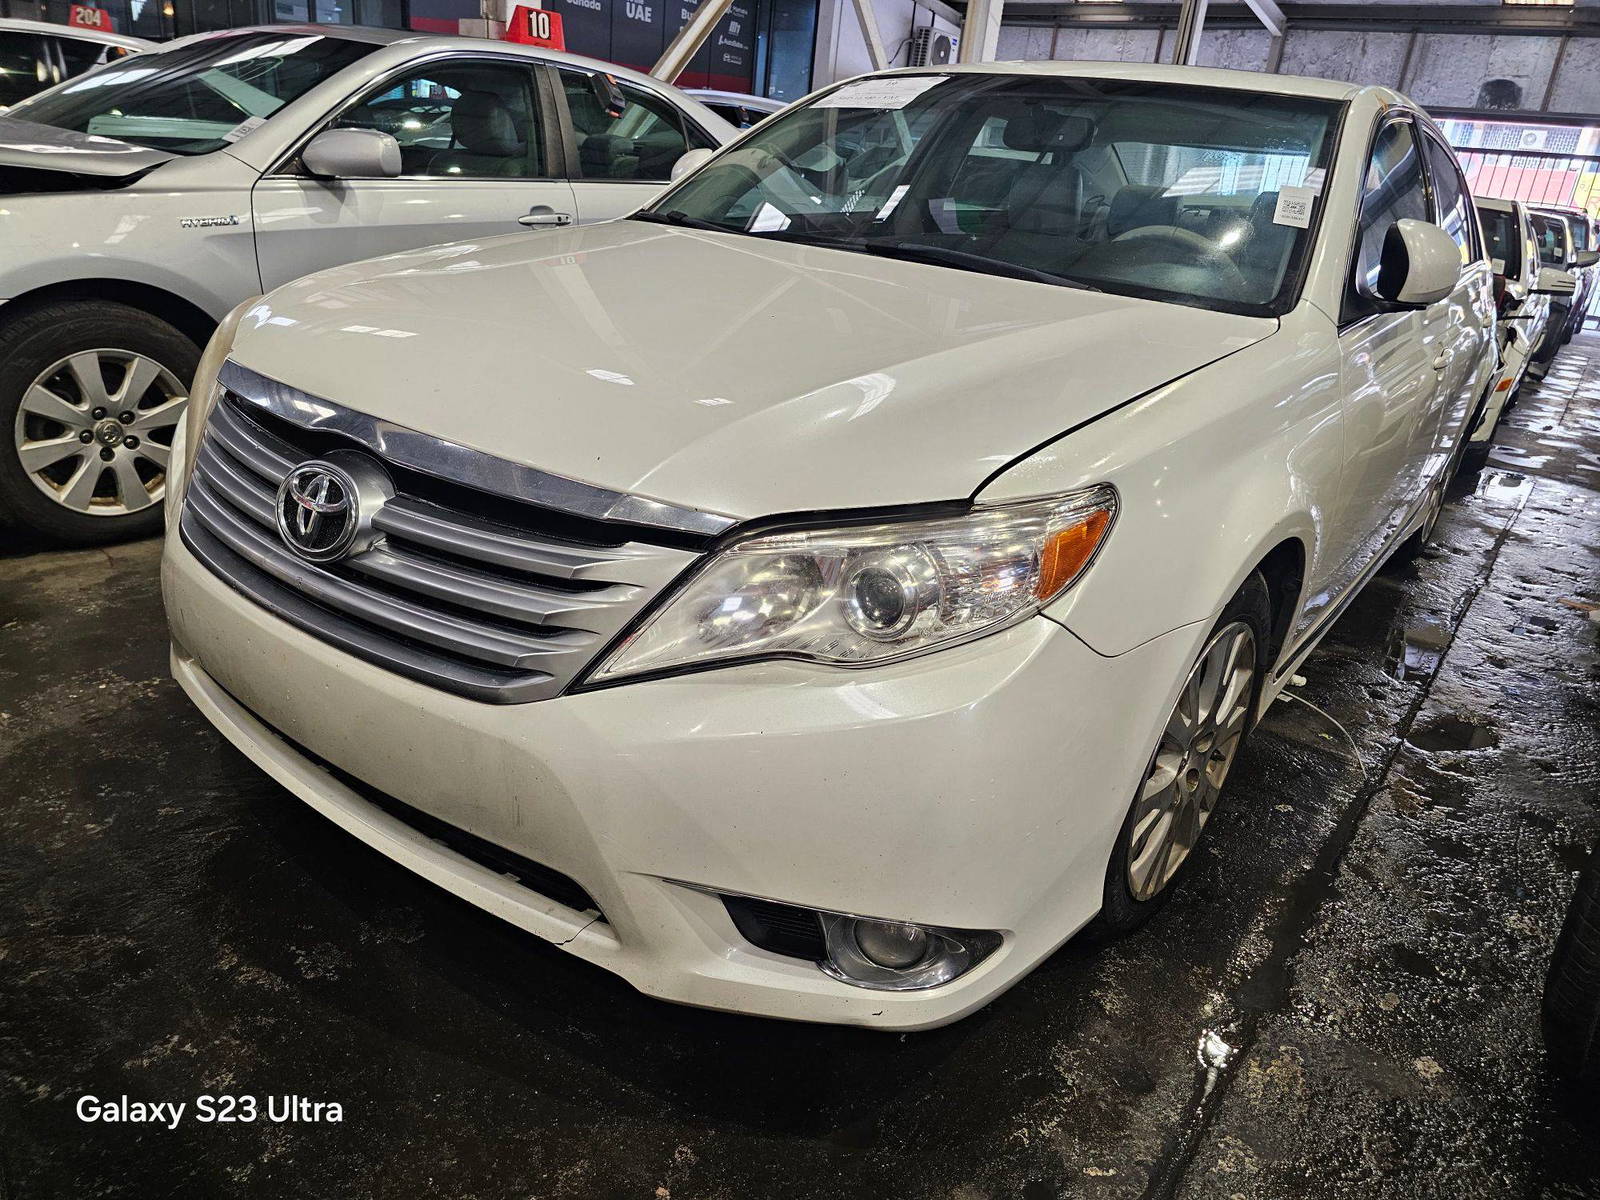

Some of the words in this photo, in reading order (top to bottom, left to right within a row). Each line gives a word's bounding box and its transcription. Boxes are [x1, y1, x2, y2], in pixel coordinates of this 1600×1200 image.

[76, 7, 101, 26] 204
[626, 2, 652, 22] UAE
[530, 11, 550, 39] 10
